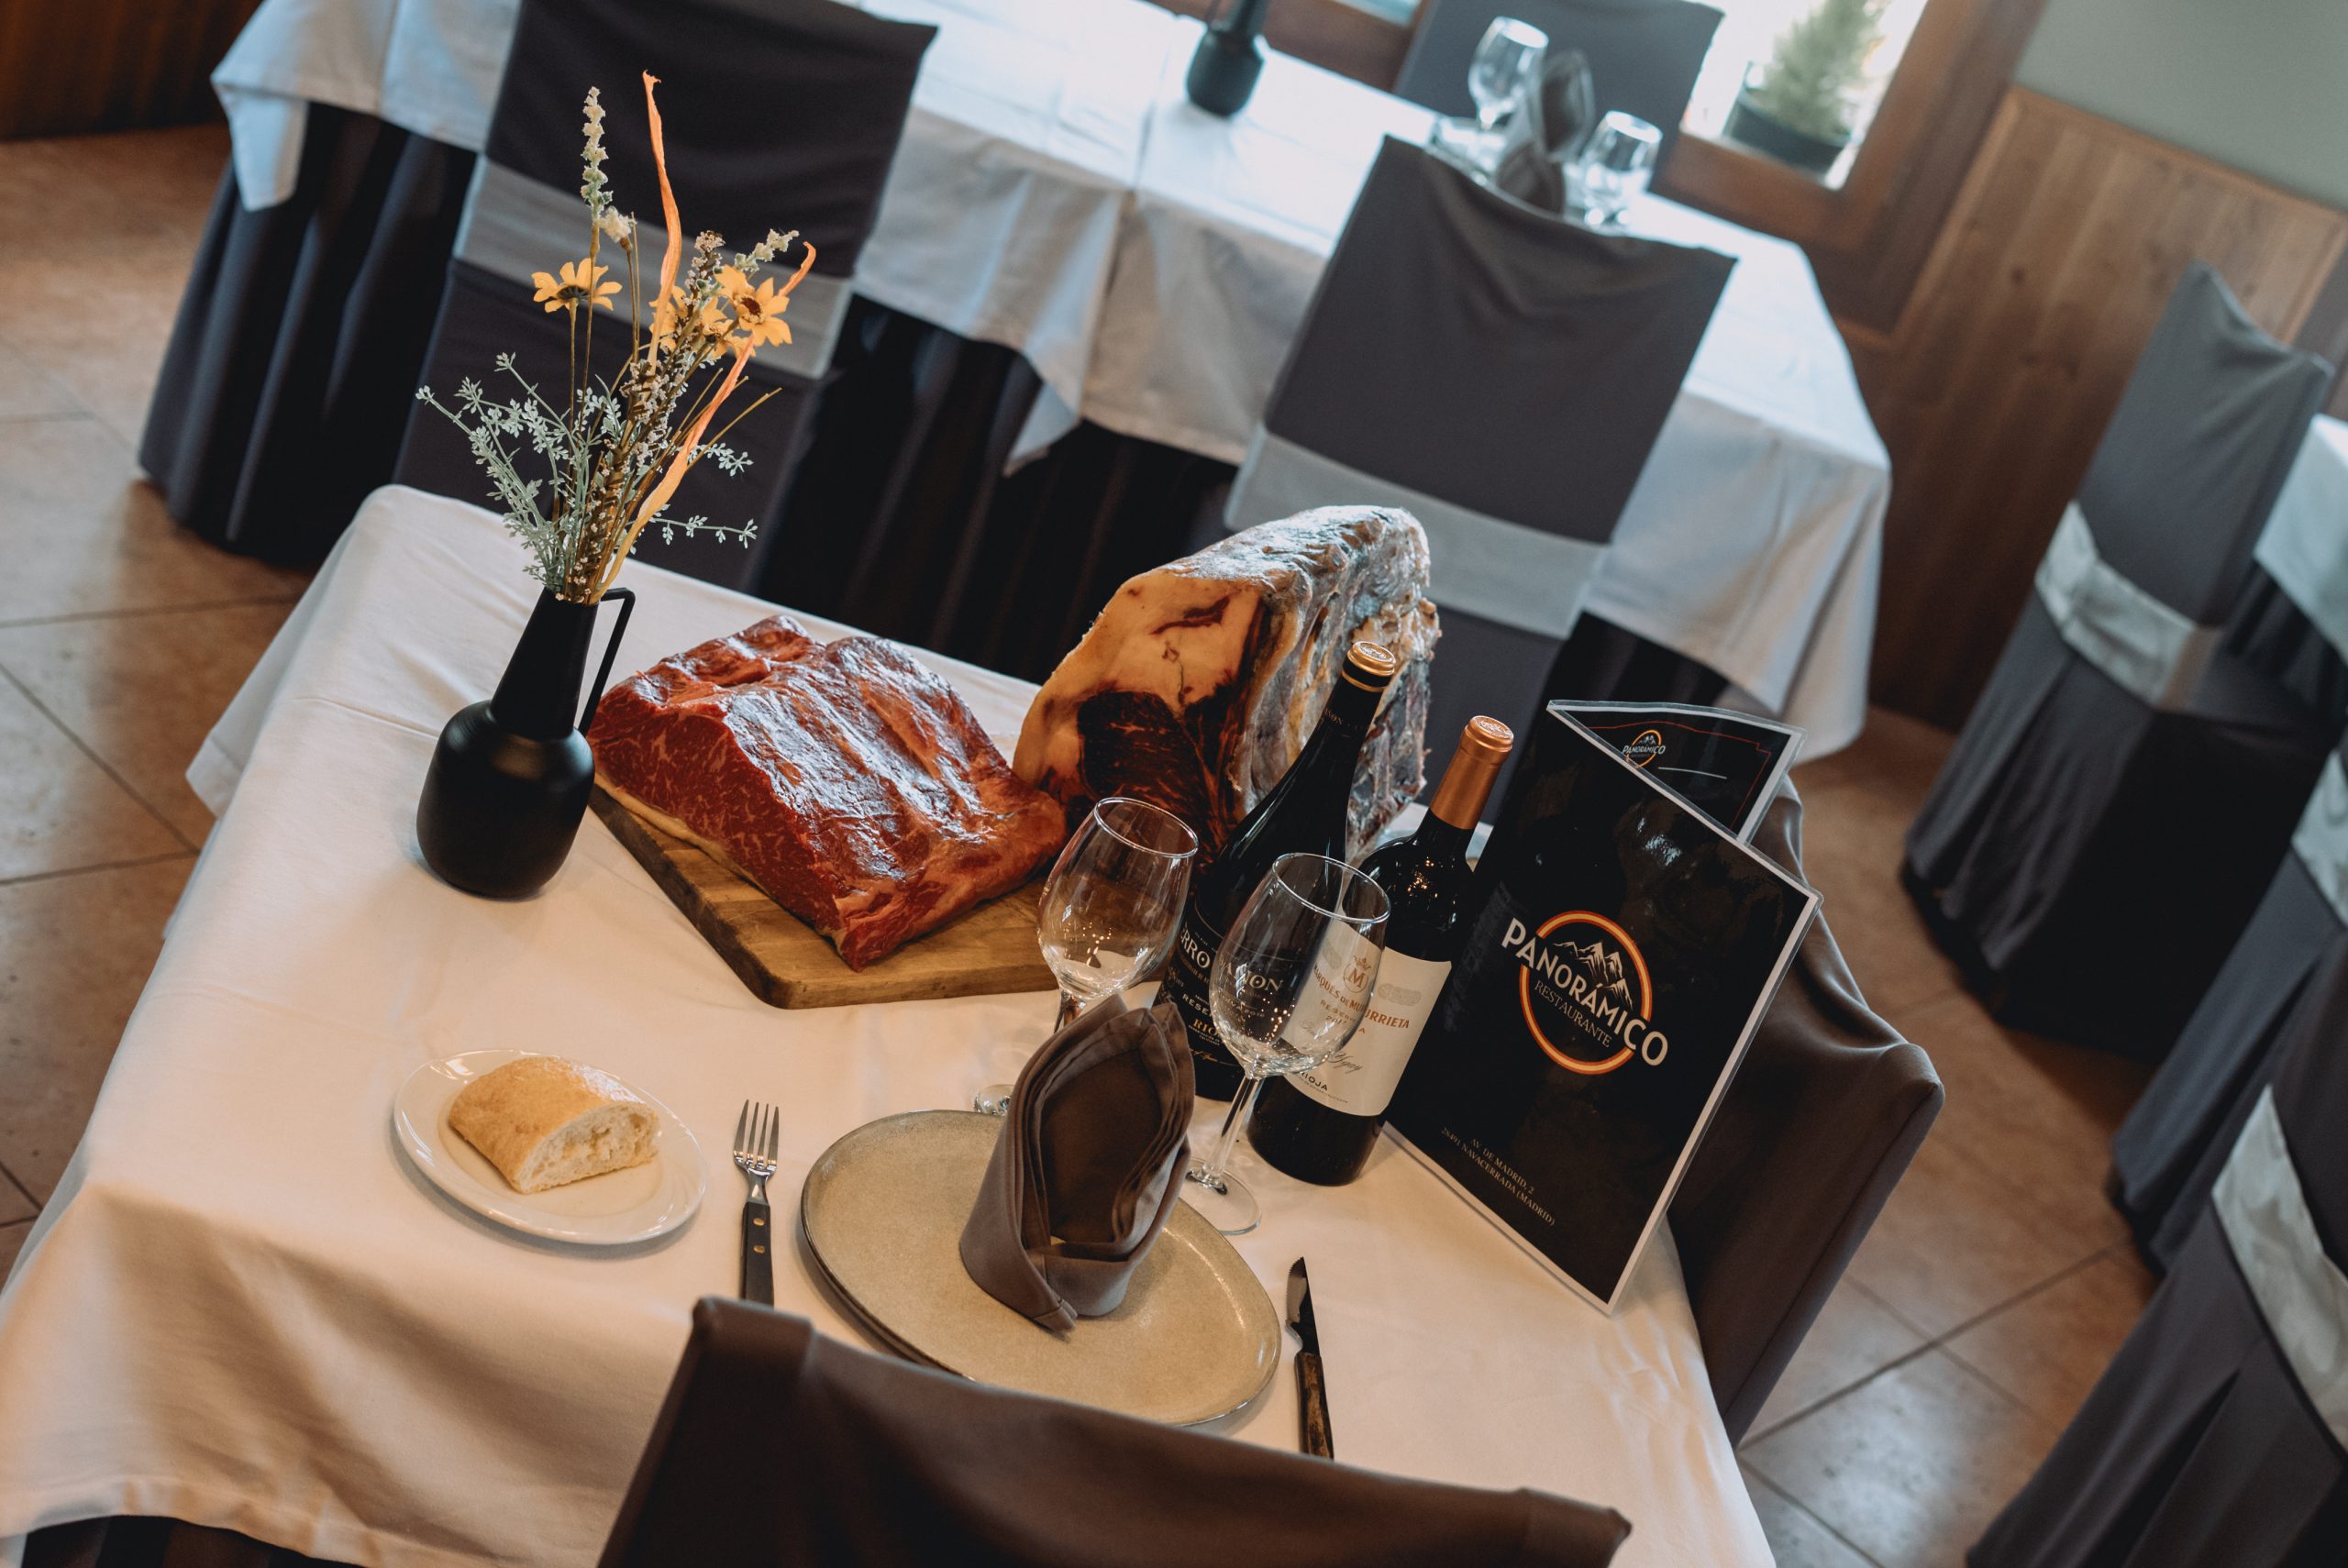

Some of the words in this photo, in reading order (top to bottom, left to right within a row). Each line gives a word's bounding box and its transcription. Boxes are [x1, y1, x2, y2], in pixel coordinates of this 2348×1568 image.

[1501, 917, 1668, 1066] PANORÁMICO
[1534, 980, 1612, 1048] RESTAURANTE
[1462, 1143, 1517, 1195] NAVACERRADA
[1516, 1190, 1556, 1226] (MADRID)
[1482, 1148, 1494, 1161] DE
[1527, 1186, 1534, 1195] 2
